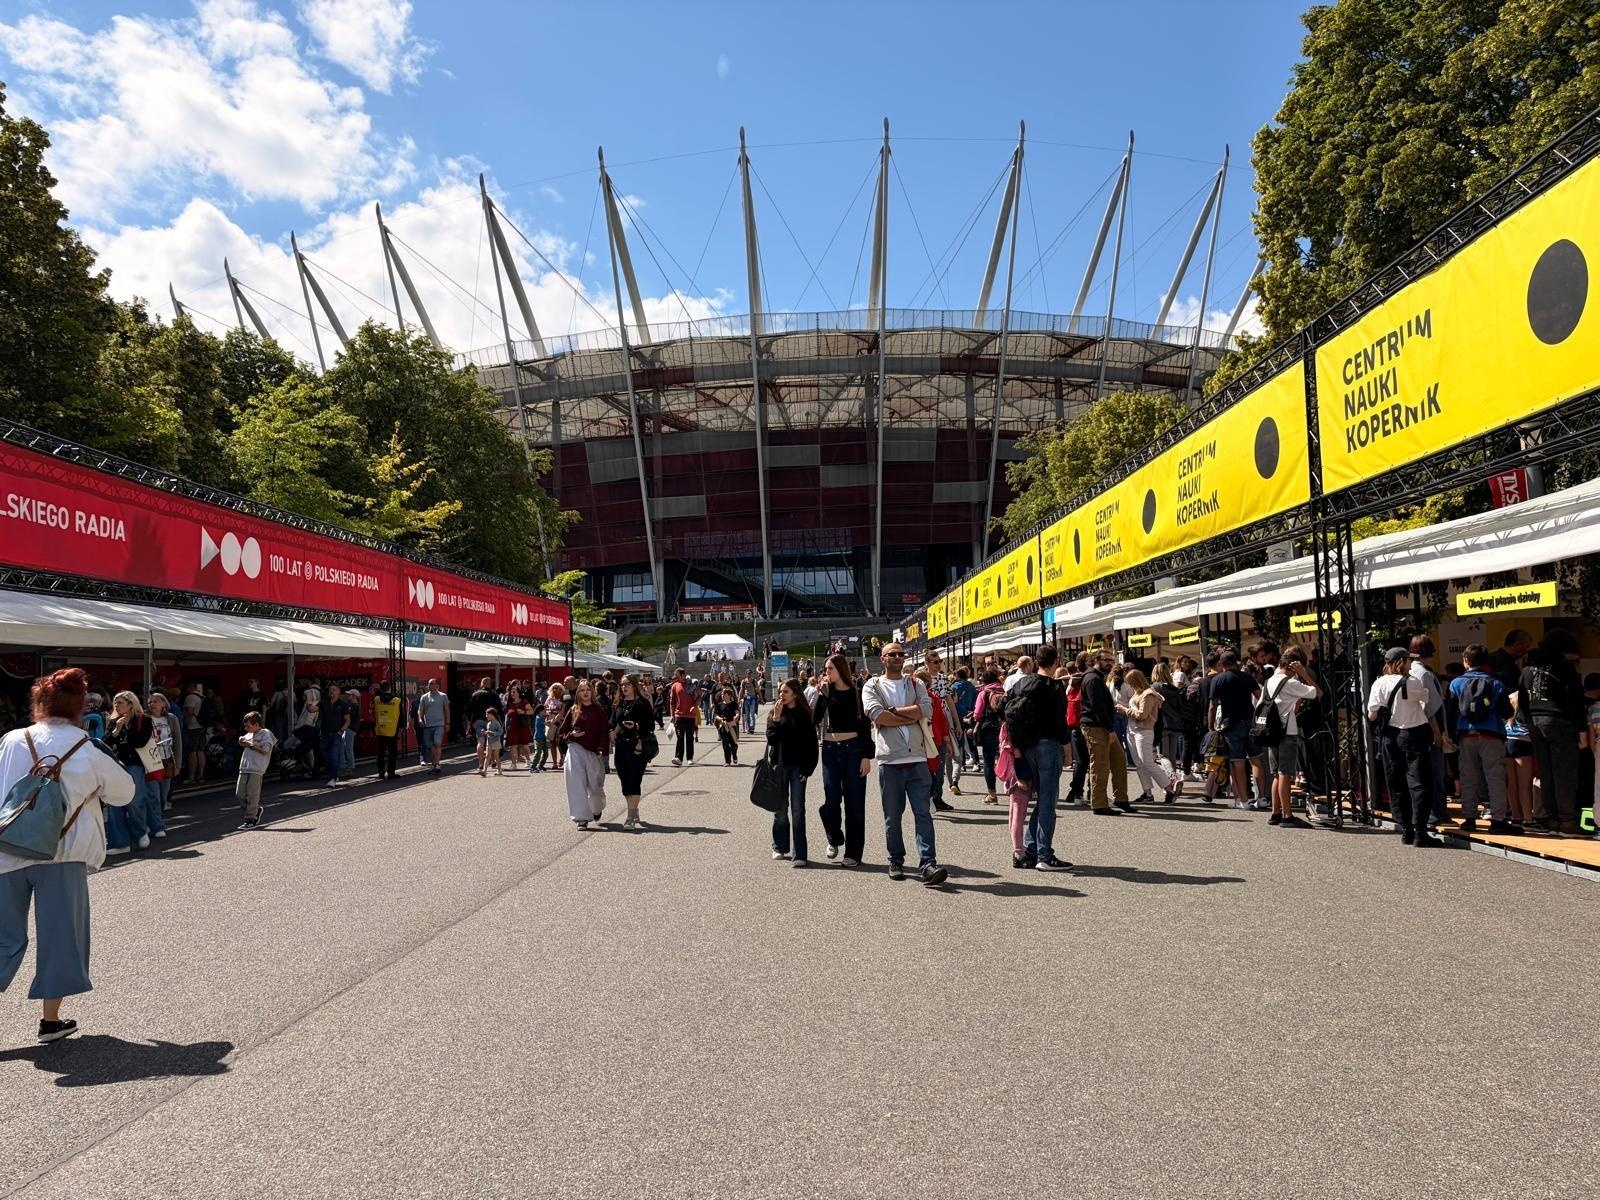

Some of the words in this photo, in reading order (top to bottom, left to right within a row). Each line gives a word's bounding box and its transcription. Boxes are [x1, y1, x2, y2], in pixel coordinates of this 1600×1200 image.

[1344, 366, 1398, 420] NAUKI
[1346, 382, 1442, 453] KOPERNIK
[1177, 473, 1202, 504] NAUKI
[1176, 489, 1220, 527] KOPERNIK
[75, 510, 126, 541] RADIA
[1095, 523, 1112, 544] NAUKI
[270, 554, 284, 574] 100
[287, 558, 302, 577] LAT
[314, 565, 356, 587] POLSKIEGO
[357, 573, 379, 591] RADIA
[438, 593, 448, 605] 100
[448, 594, 457, 607] LAT
